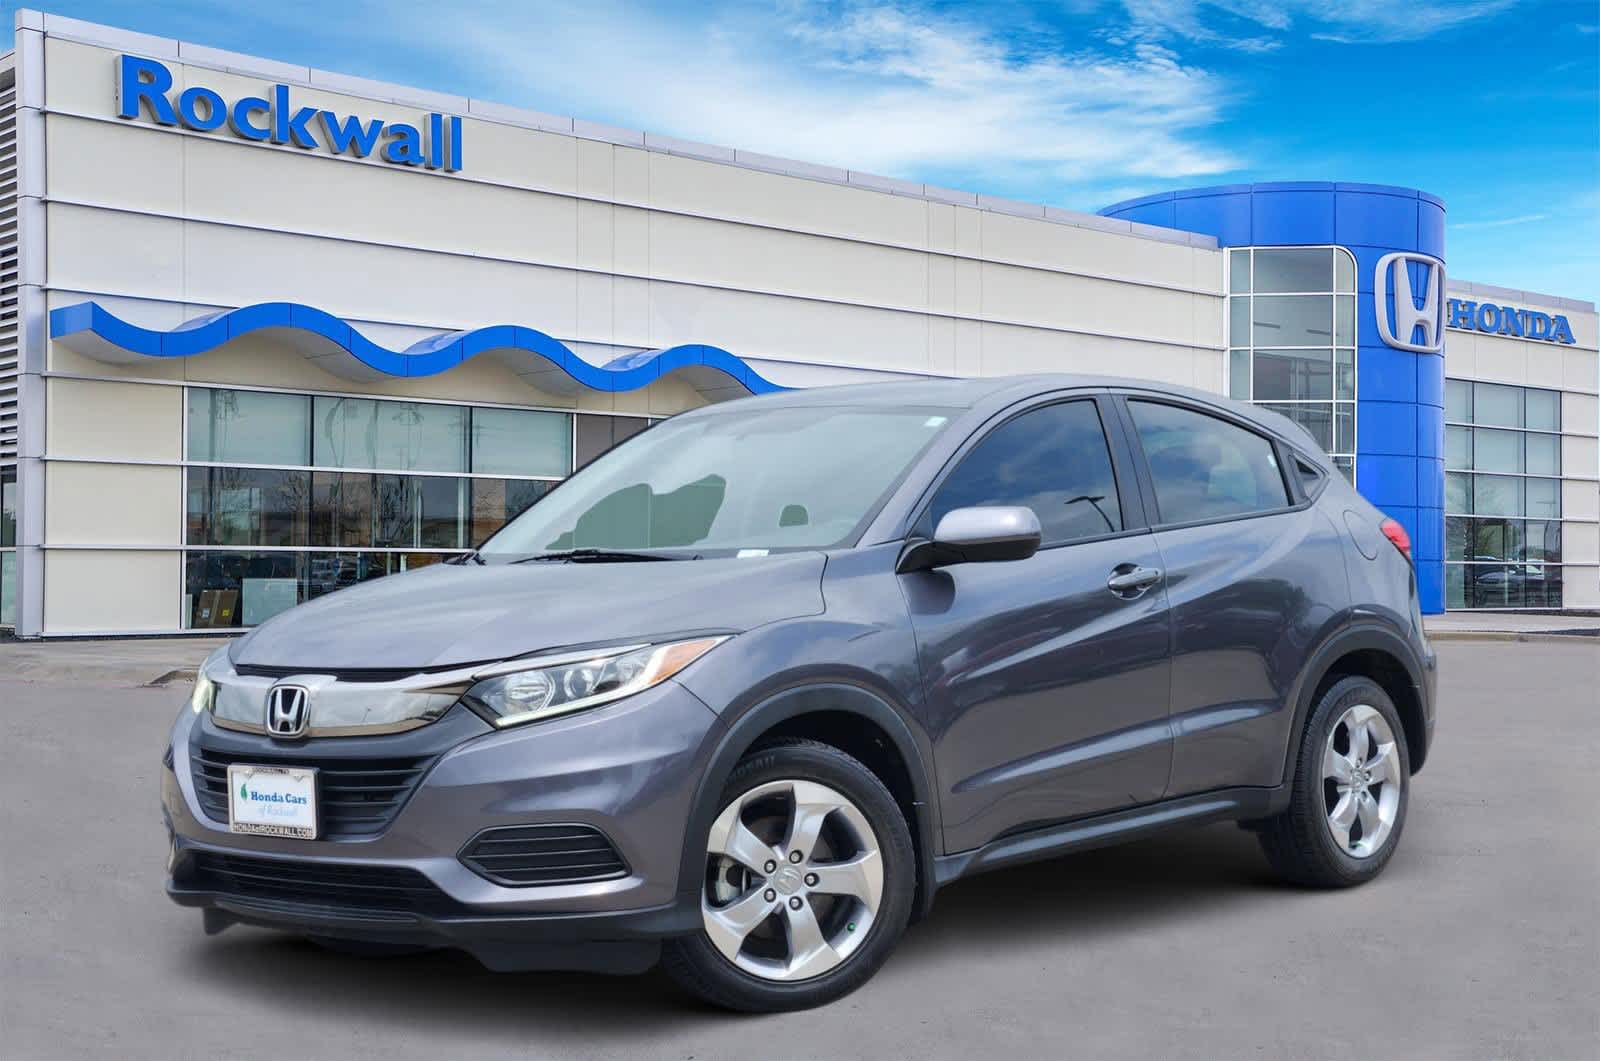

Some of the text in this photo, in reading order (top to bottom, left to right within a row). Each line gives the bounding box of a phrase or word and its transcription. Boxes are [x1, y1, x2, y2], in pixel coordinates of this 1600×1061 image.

[117, 54, 463, 172] Rockwall
[1446, 298, 1576, 344] HONDA
[251, 791, 307, 805] Honda Cars
